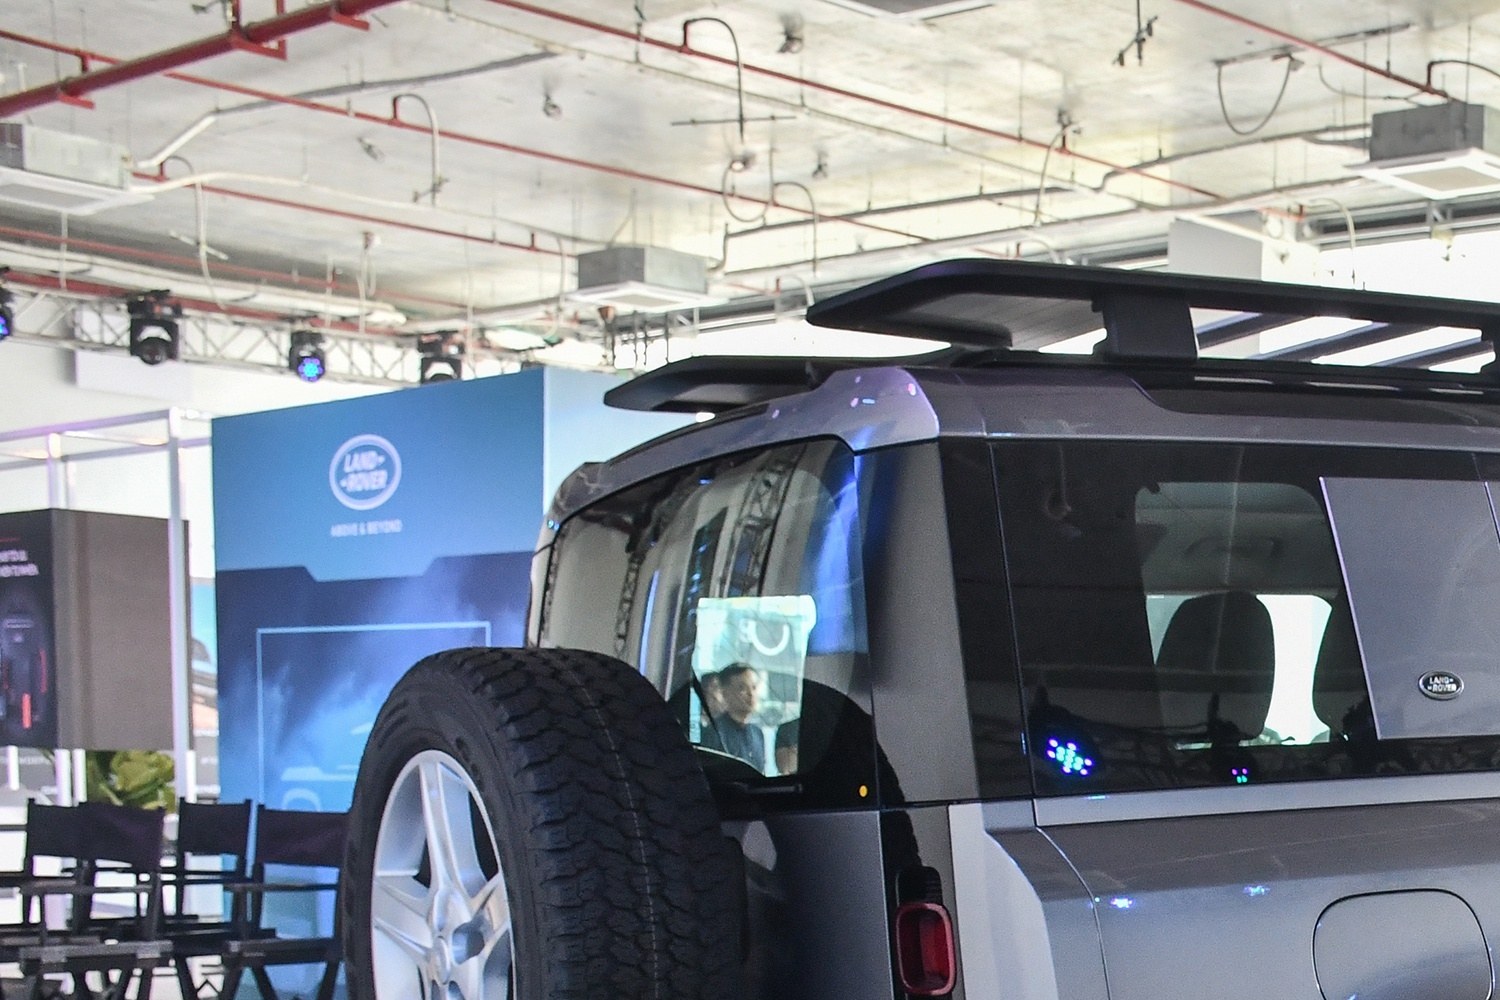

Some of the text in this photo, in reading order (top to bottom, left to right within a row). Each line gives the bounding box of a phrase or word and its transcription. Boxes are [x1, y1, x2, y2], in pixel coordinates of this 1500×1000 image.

[343, 450, 379, 473] LAND
[345, 469, 389, 492] ROVER
[1429, 676, 1450, 685] LAND
[1432, 683, 1457, 692] ROVER
